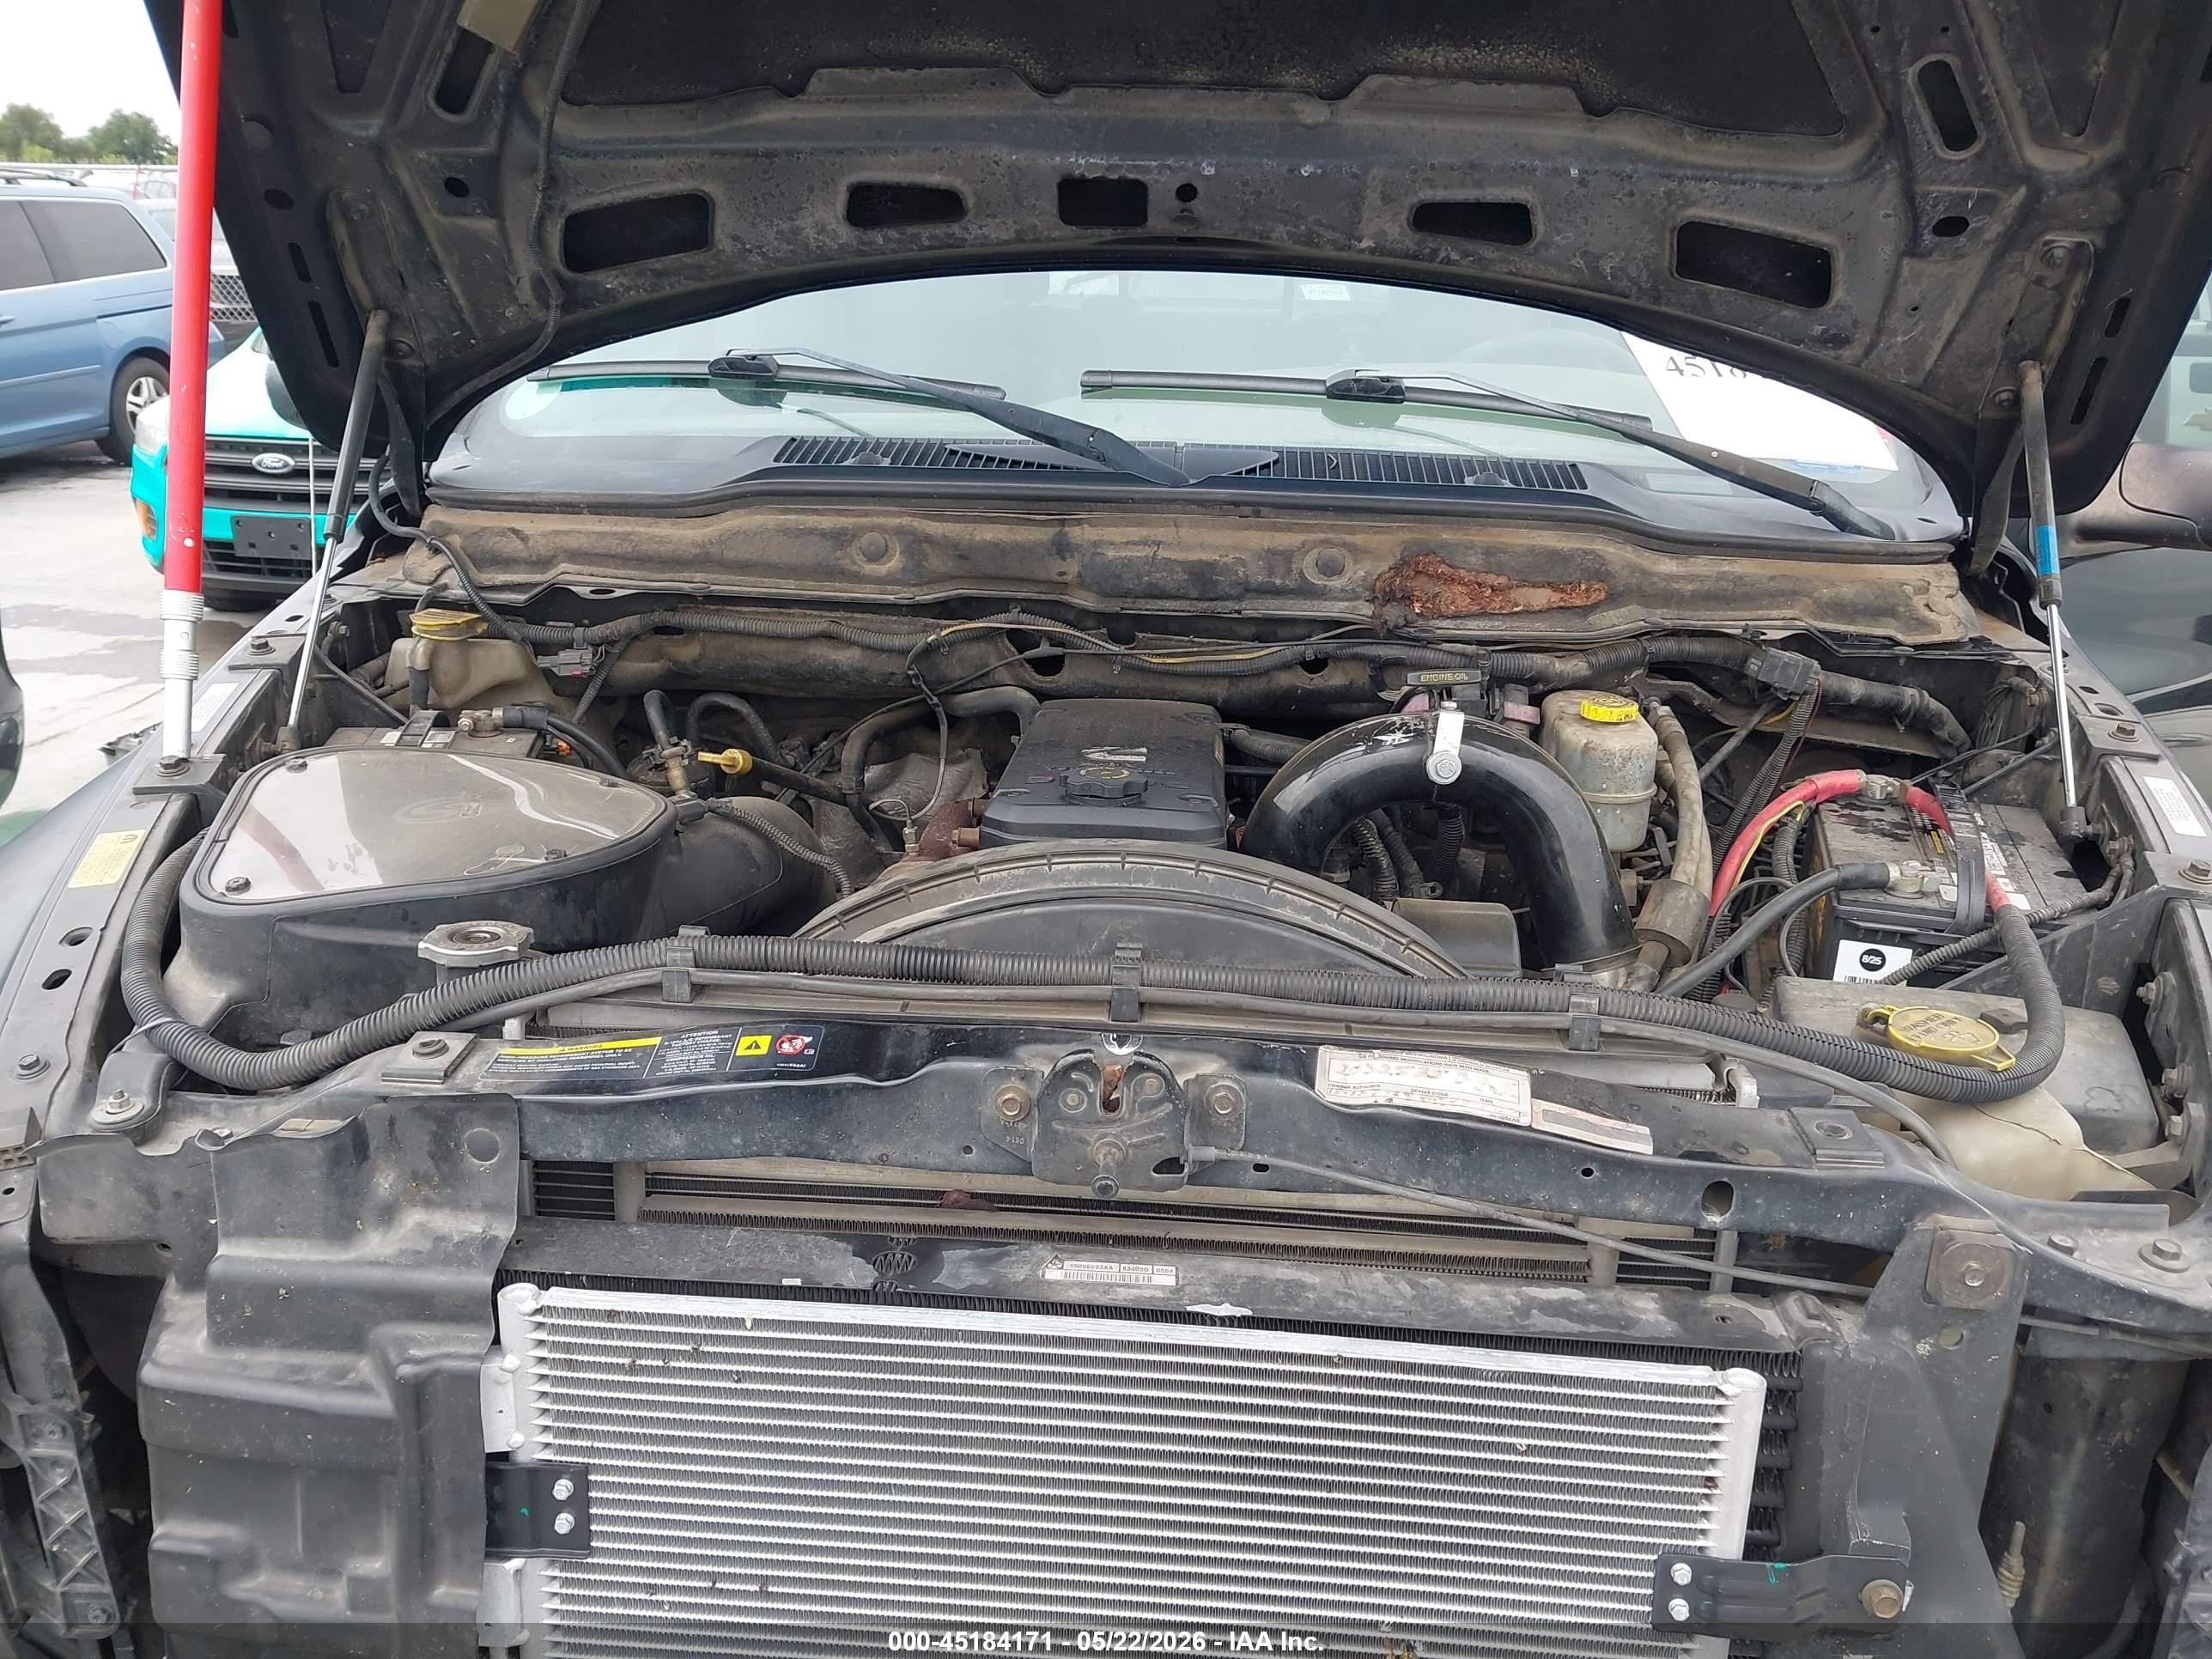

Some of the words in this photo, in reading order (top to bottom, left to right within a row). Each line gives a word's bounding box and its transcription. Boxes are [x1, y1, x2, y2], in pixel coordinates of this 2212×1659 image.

[261, 458, 283, 468] Ford
[1420, 673, 1454, 682] ENGINE
[1455, 672, 1468, 681] OIL
[1862, 954, 1882, 965] 8/25
[1899, 1012, 1945, 1032] WASHER
[680, 1030, 719, 1039] ATTENTION
